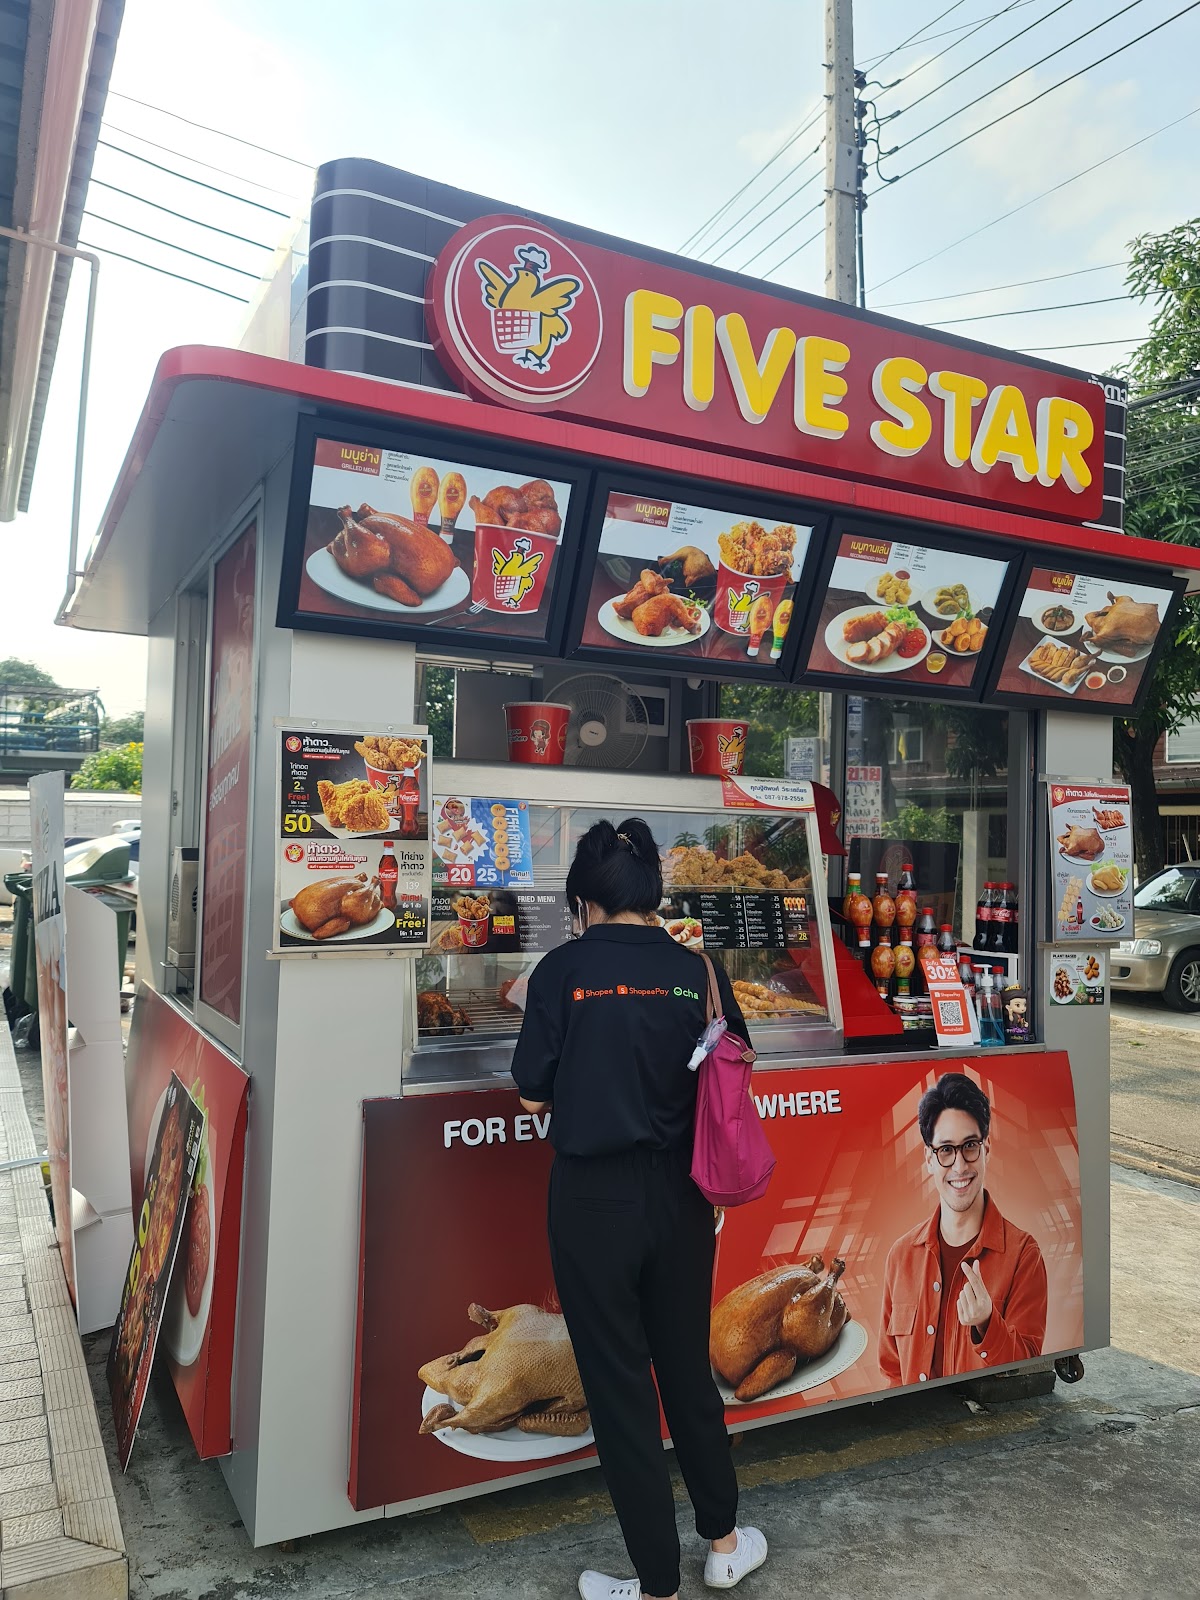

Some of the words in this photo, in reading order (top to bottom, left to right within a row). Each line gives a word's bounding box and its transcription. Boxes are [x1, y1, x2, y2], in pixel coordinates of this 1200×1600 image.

[623, 288, 851, 440] FIVE
[869, 356, 1095, 494] STAR
[341, 447, 380, 464] เมนูย่าง
[341, 463, 363, 472] GRILLED
[363, 467, 379, 475] MENU
[635, 504, 669, 517] เมนูทอด
[851, 541, 890, 554] เมนูทานเล่น
[1052, 575, 1073, 587] เมนูเป็ด
[290, 762, 309, 770] ไก่ทอด
[847, 766, 881, 781] ขาย
[293, 780, 301, 790] 2
[400, 851, 424, 861] ไก่ย่าง
[400, 862, 425, 870] ห้าดาว
[476, 868, 497, 882] 25
[405, 881, 420, 890] 139
[396, 919, 426, 928] Free!
[798, 932, 808, 941] 28
[927, 966, 955, 980] 30%
[585, 989, 614, 997] Shopee
[628, 987, 670, 996] ShopeePay
[673, 986, 699, 1000] Ocha
[754, 1089, 842, 1119] WHERE
[443, 1117, 506, 1148] FOR
[513, 1113, 552, 1142] EV
